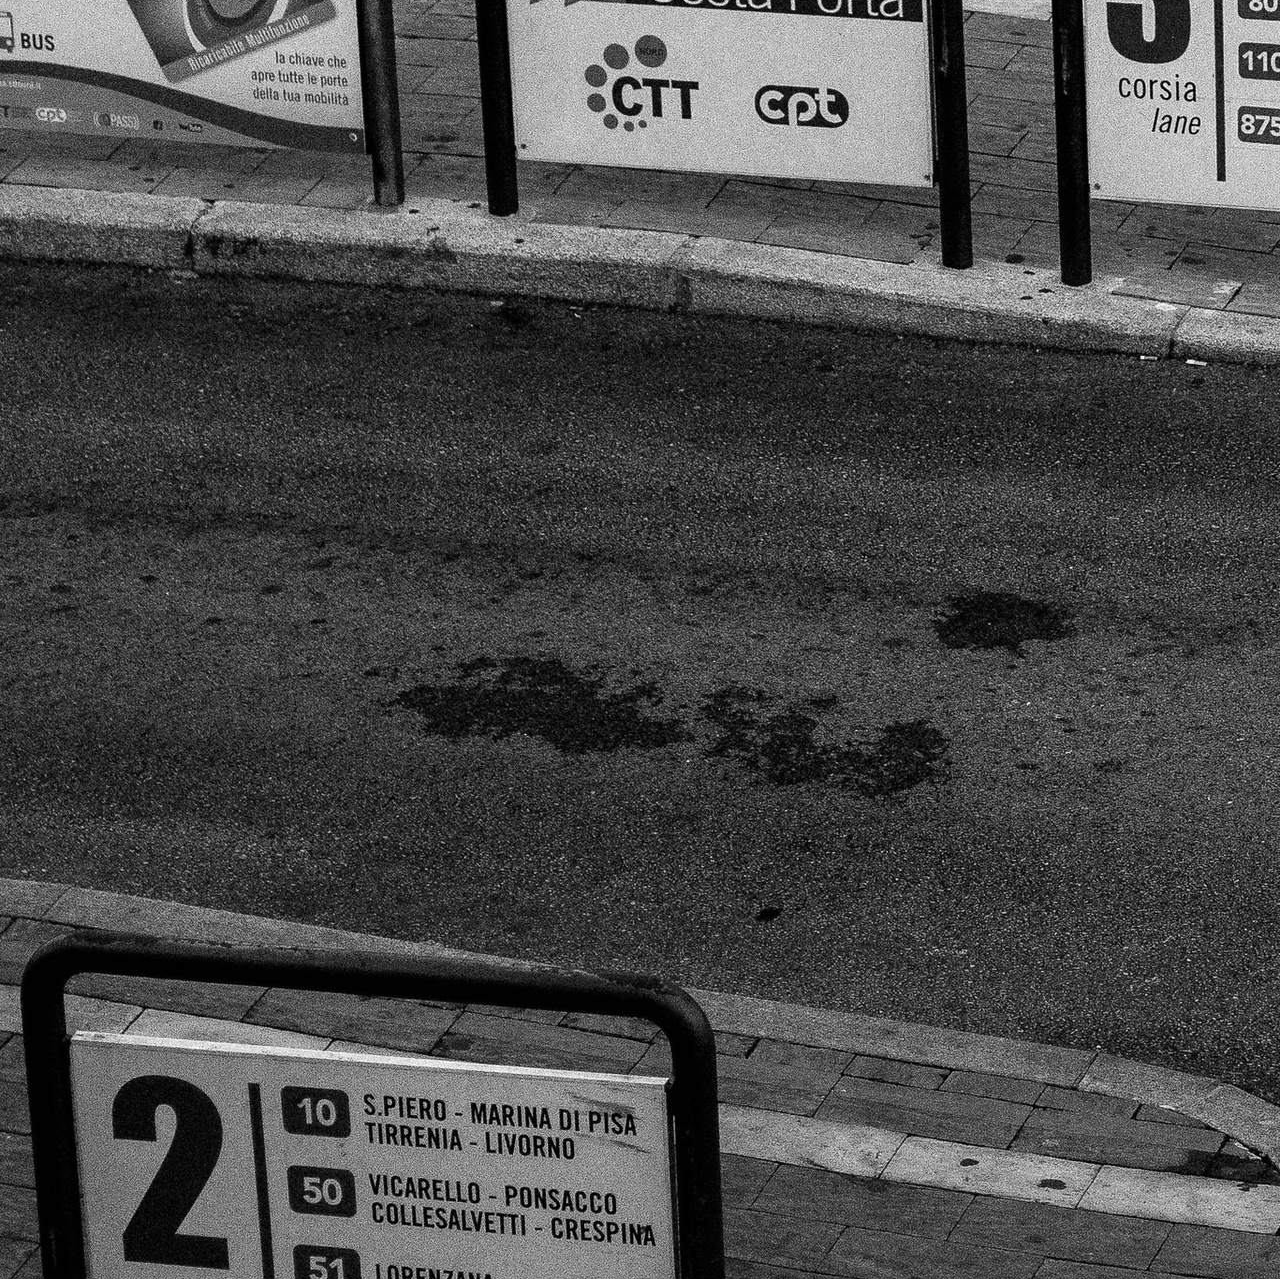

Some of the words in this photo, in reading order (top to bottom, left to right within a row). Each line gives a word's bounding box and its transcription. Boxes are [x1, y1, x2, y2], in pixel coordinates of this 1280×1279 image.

[20, 31, 56, 52] BUS
[187, 39, 246, 72] Ricaricabile
[247, 14, 311, 50] Multifunzione
[275, 51, 286, 66] la
[289, 51, 325, 68] chiave
[327, 54, 347, 69] che
[251, 71, 275, 86] apre
[278, 70, 305, 86] tutte
[308, 71, 318, 87] le
[320, 74, 348, 90] porte
[1118, 74, 1198, 103] corsia
[253, 86, 279, 102] della
[283, 88, 301, 103] tua
[304, 89, 349, 107] mobilità
[611, 76, 699, 120] CTT
[754, 85, 849, 129] cpt
[1151, 108, 1202, 136] lane
[297, 1096, 337, 1127] 10
[363, 1093, 447, 1122] S.PIERO
[470, 1102, 553, 1130] MARINA
[559, 1108, 581, 1133] DI
[588, 1111, 638, 1137] PISA
[366, 1122, 463, 1152] TIRRENIA
[485, 1132, 576, 1161] LIVORNO
[112, 1074, 230, 1271] 2
[302, 1176, 343, 1207] 50
[368, 1173, 481, 1205] VICARELLO
[504, 1184, 617, 1216] PONSACCO
[371, 1202, 527, 1237] COLLESALVETTI
[550, 1217, 657, 1247] CRESPINA
